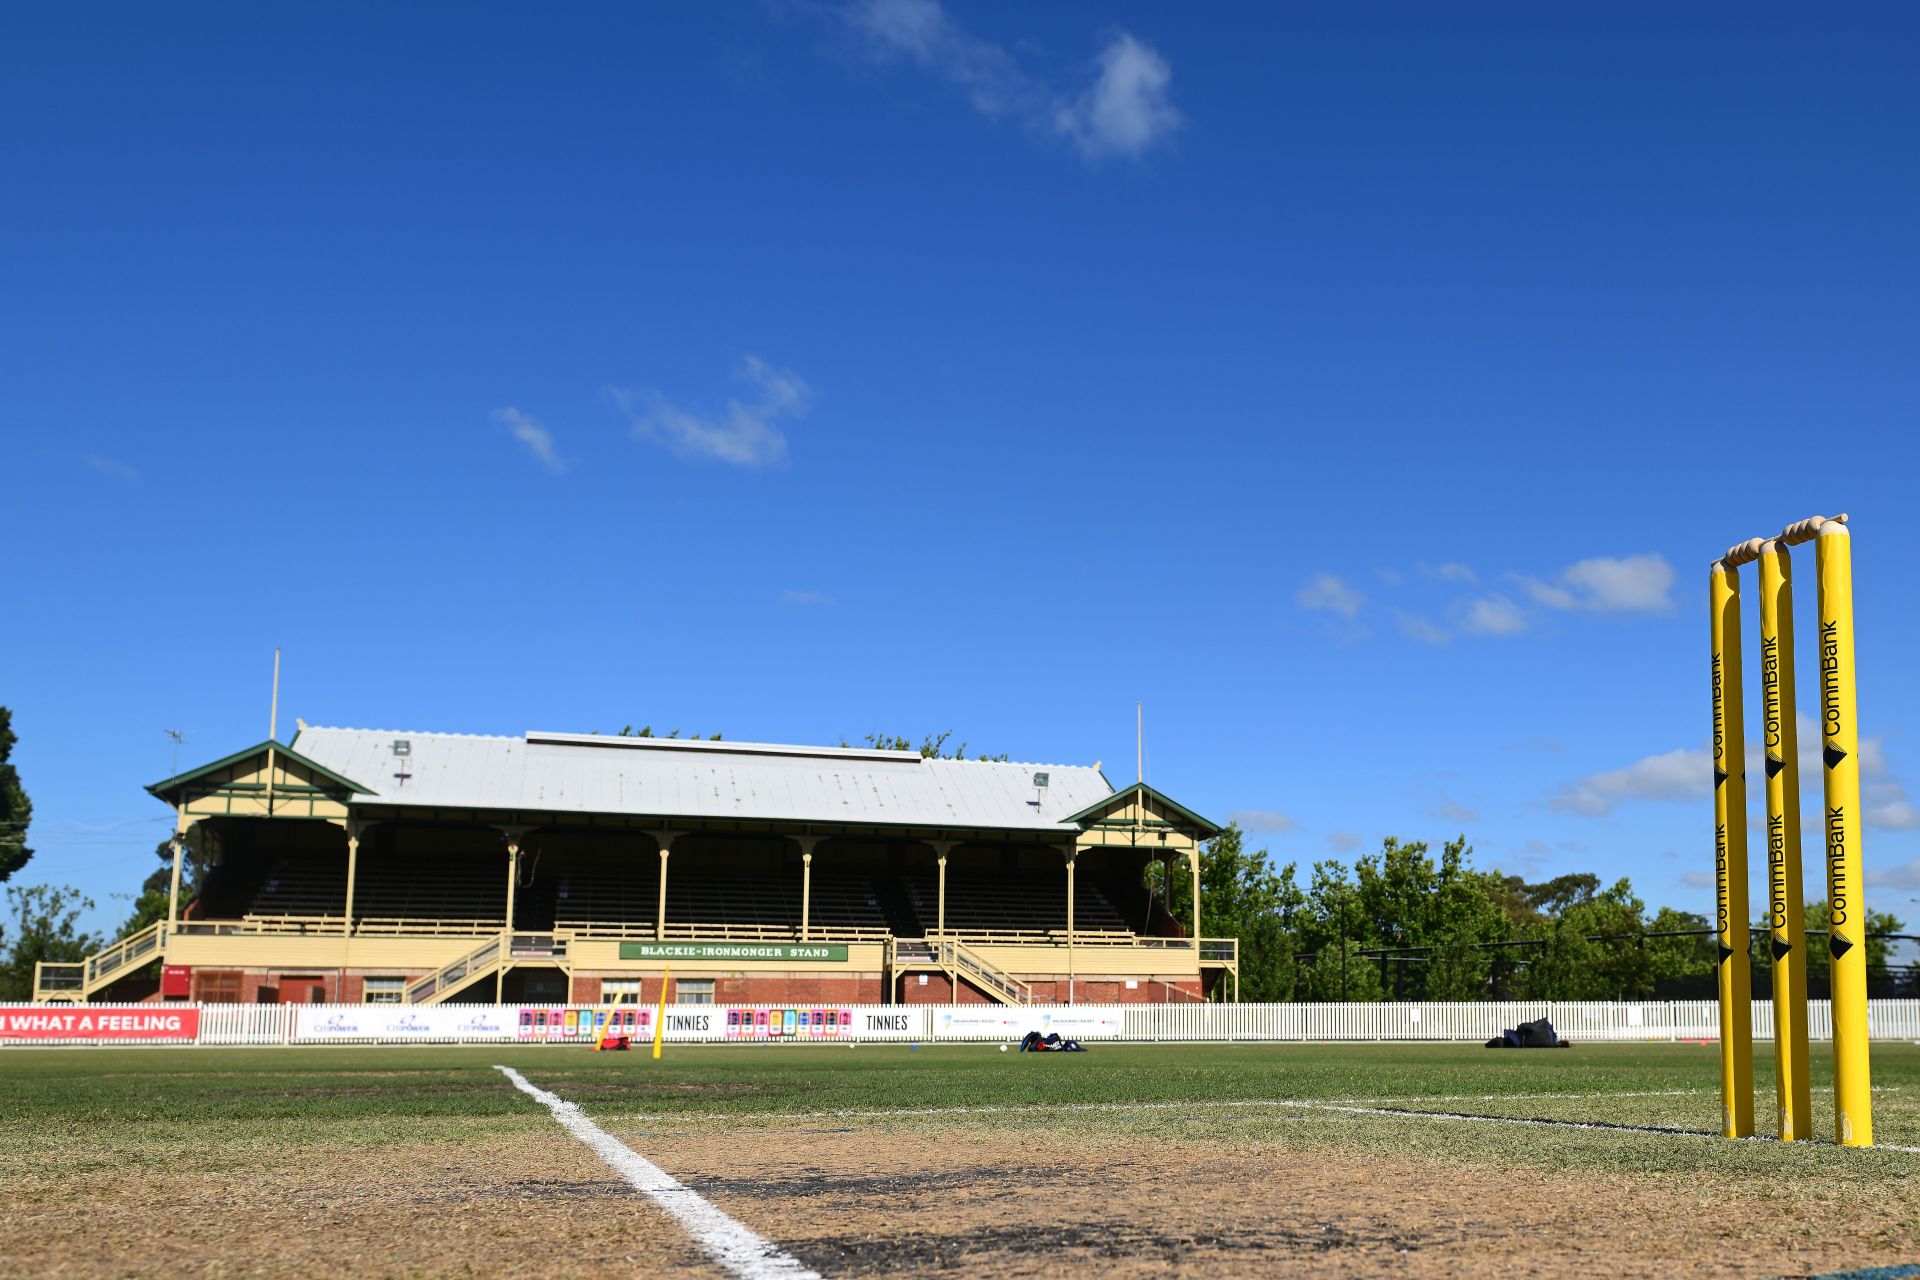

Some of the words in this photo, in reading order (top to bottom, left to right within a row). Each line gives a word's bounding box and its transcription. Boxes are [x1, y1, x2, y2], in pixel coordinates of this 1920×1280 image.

[1763, 636, 1780, 747] CommBank
[1821, 620, 1841, 737] CommBank
[1715, 823, 1728, 934] CommBank
[1768, 814, 1786, 929] CommBank
[1828, 806, 1847, 926] CommBank
[641, 946, 782, 957] BLACKIE-IRONMONGER
[790, 948, 829, 958] STAND
[9, 1015, 74, 1030] WHAT
[78, 1015, 93, 1030] A
[98, 1015, 181, 1030] FEELING
[666, 1015, 709, 1031] TINNIES
[866, 1015, 908, 1031] TINNIES
